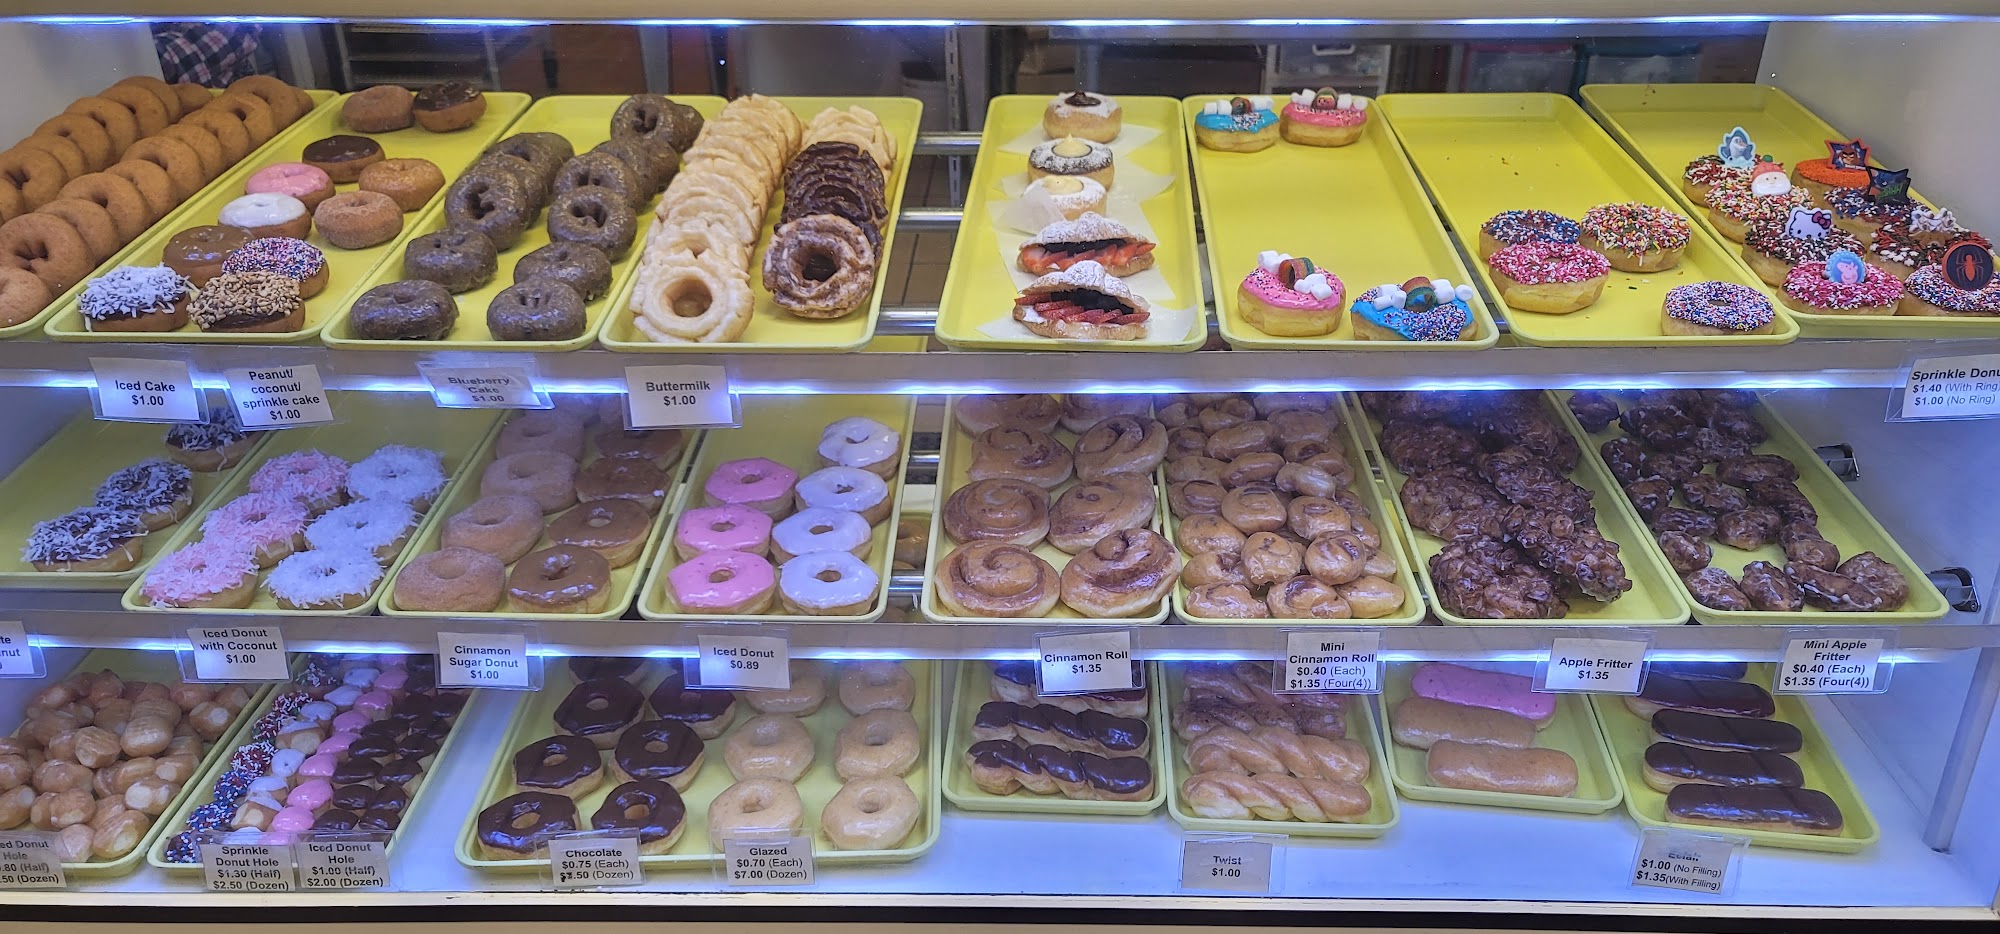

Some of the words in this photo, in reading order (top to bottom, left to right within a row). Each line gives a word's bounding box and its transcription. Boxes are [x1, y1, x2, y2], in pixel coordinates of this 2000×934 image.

[248, 368, 293, 381] Peanut/
[1911, 368, 1966, 382] Sprinkle
[1970, 367, 2000, 378] Donu
[115, 379, 141, 391] Iced
[144, 381, 175, 392] Cake
[448, 377, 510, 385] Blueberry
[645, 381, 711, 392] Buttermilk
[251, 381, 301, 394] coconut/
[1912, 384, 1942, 394] $1.40
[1945, 383, 1972, 394] (With
[131, 394, 164, 406] $1.00
[242, 396, 289, 410] sprinkle
[292, 394, 320, 405] cake
[663, 395, 696, 406] $1.00
[1914, 396, 1944, 406] $1.00
[1946, 396, 1966, 406] (No
[1968, 394, 1996, 405] Ring)
[269, 409, 301, 421] $1.00
[203, 629, 228, 638] Iced
[231, 628, 268, 638] Donut
[200, 641, 224, 650] with
[227, 641, 278, 650] Coconut
[454, 645, 511, 655] Cinnamon
[1320, 642, 1345, 652] Mini
[1803, 640, 1829, 649] Mini
[1831, 640, 1867, 651] Apple
[713, 647, 737, 656] Iced
[740, 648, 774, 658] Donut
[1044, 653, 1102, 663] Cinnamon
[1105, 651, 1128, 660] Roll
[1813, 652, 1851, 661] Fritter
[226, 654, 256, 664] $1.00
[449, 657, 482, 668] Sugar
[485, 658, 519, 668] Donut
[1289, 655, 1348, 664] Cinnamon
[1351, 653, 1375, 663] Roll
[1558, 657, 1593, 668] Apple
[1596, 658, 1633, 669] Fritter
[730, 660, 759, 670] $0.89
[1071, 663, 1102, 674] $1.35
[1792, 664, 1824, 674] $0.40
[1827, 664, 1866, 675] (Each)
[470, 670, 499, 679] $1.00
[1296, 666, 1327, 676] $0.40
[1330, 665, 1366, 677] (Each)
[1577, 670, 1610, 680] $1.35
[1290, 679, 1320, 689] $1.35
[1323, 678, 1372, 690] (Four(4))
[1783, 676, 1816, 687] $1.35
[1818, 677, 1869, 688] (Four(4))
[0, 840, 13, 849] ed
[15, 840, 49, 849] Donut
[309, 843, 333, 852] Iced
[336, 843, 372, 852] Donut
[3, 851, 28, 860] Hole
[222, 846, 269, 856] Sprinkle
[565, 848, 622, 858] Chocolate
[749, 847, 787, 856] Glazed
[216, 857, 251, 867] Donut
[253, 857, 279, 867] Hole
[328, 855, 355, 864] Hole
[562, 860, 592, 870] $0.75
[594, 859, 629, 870] (Each)
[736, 859, 766, 868] $0.70
[768, 858, 803, 869] (Each)
[1212, 855, 1242, 865] Twist
[0, 863, 17, 872] .80
[20, 862, 49, 873] (Half)
[312, 866, 341, 876] $1.00
[344, 865, 376, 877] (Half)
[1211, 867, 1241, 877] $1.00
[1641, 858, 1671, 870] $1.00
[1673, 864, 1690, 873] (No
[1692, 866, 1722, 878] Filling)
[0, 874, 14, 883] .50
[17, 873, 59, 885] (Dozen)
[217, 869, 247, 878] $1.30
[250, 869, 281, 880] (Half)
[592, 870, 634, 881] (Dozen)
[734, 870, 763, 880] $7.00
[766, 869, 807, 881] (Dozen)
[213, 880, 243, 891] $2.50
[246, 880, 289, 892] (Dozen)
[307, 878, 336, 888] $2.00
[339, 876, 383, 888] (Dozen)
[1691, 878, 1721, 891] Filling)
